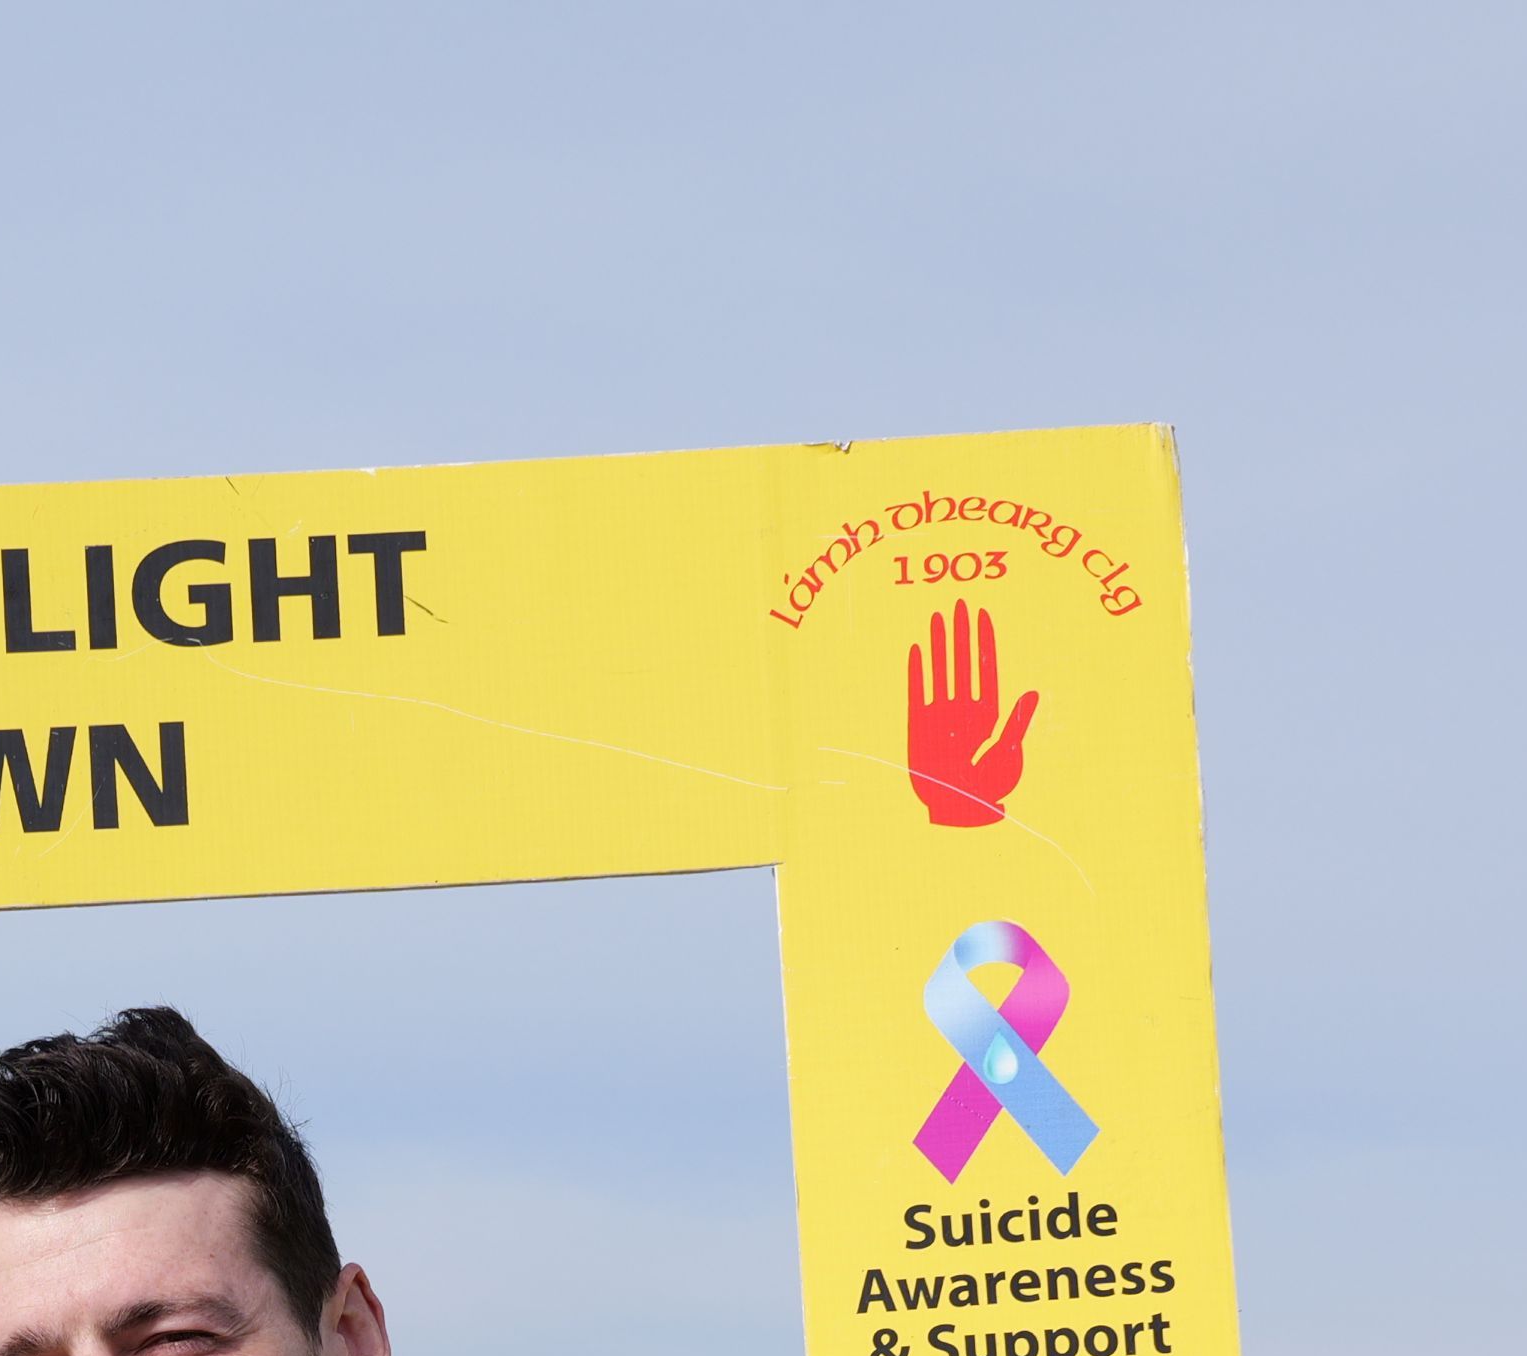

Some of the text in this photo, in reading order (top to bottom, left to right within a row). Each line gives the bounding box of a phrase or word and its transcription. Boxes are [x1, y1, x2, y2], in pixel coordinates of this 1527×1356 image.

[1, 530, 427, 653] LIGHT
[893, 551, 1008, 584] 1903
[904, 1192, 1118, 1250] Suicide
[857, 1260, 1175, 1314] Awareness
